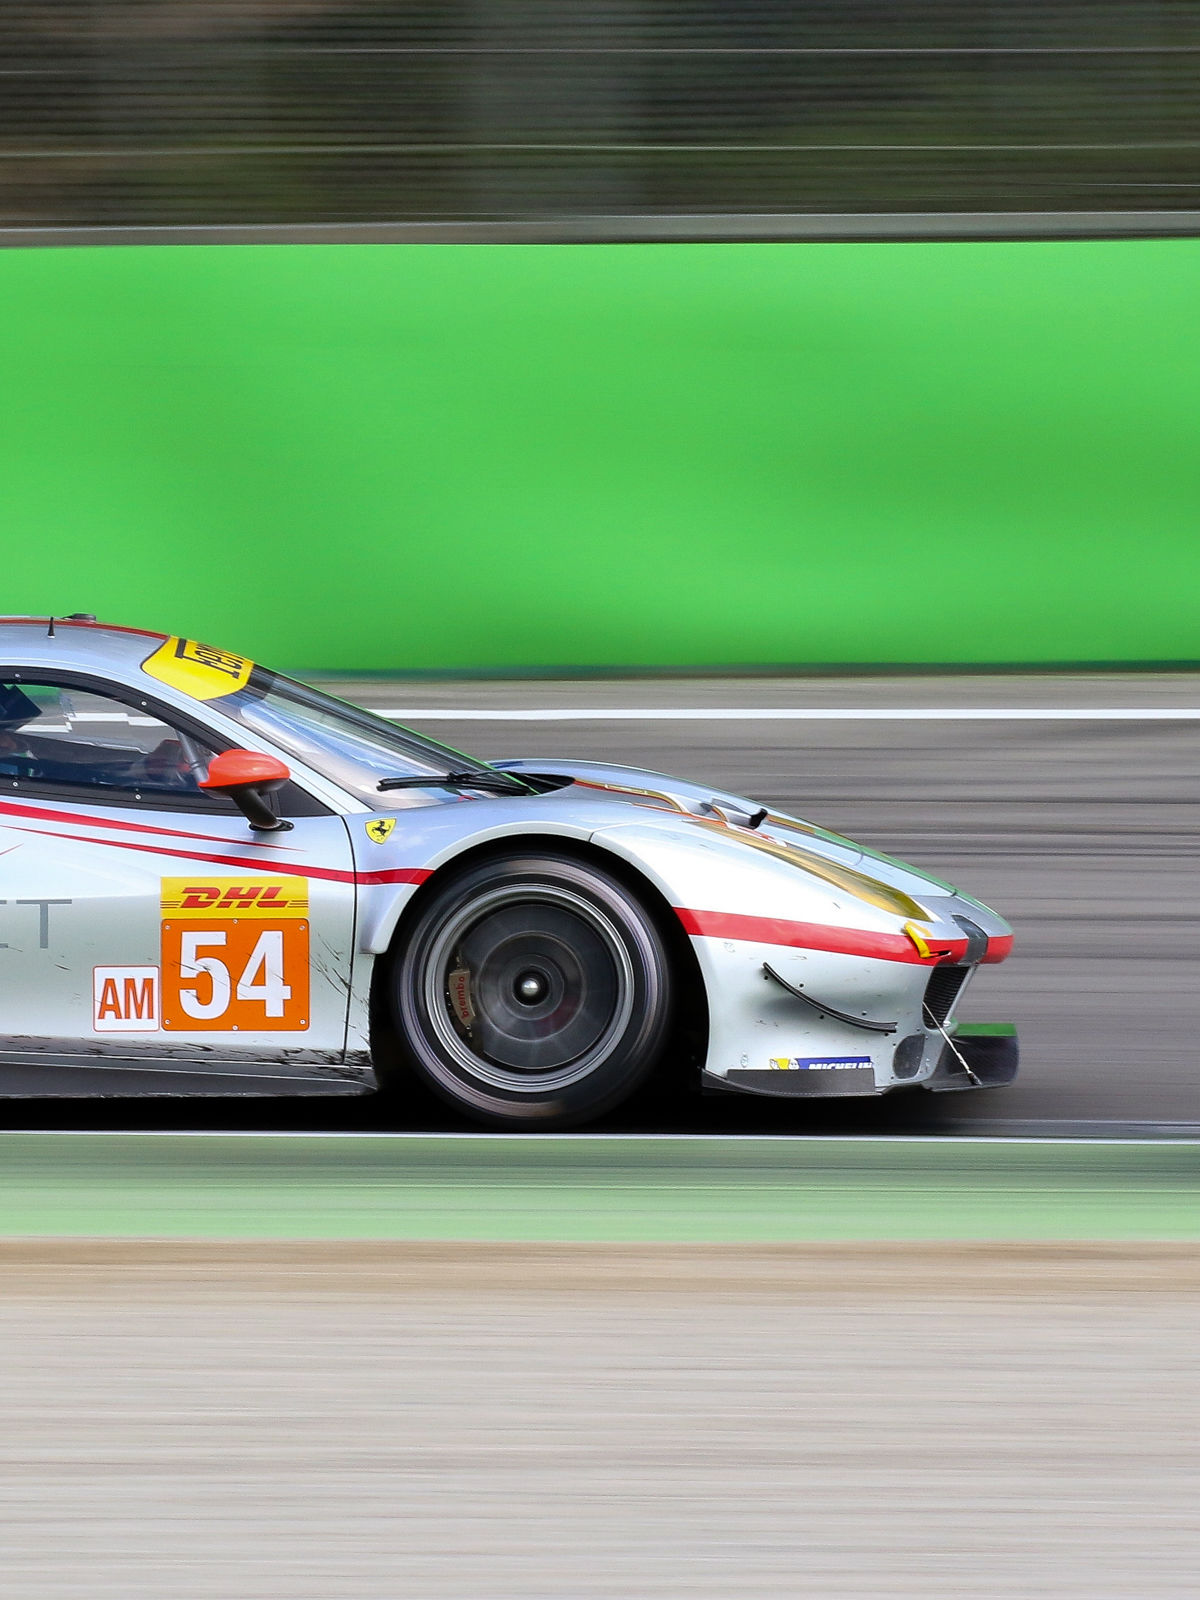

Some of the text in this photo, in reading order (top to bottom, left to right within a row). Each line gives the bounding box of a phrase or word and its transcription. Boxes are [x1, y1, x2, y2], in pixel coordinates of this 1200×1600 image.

[181, 886, 290, 909] DHL
[178, 930, 292, 1020] 54
[97, 977, 155, 1020] AM
[455, 975, 470, 1020] brembo
